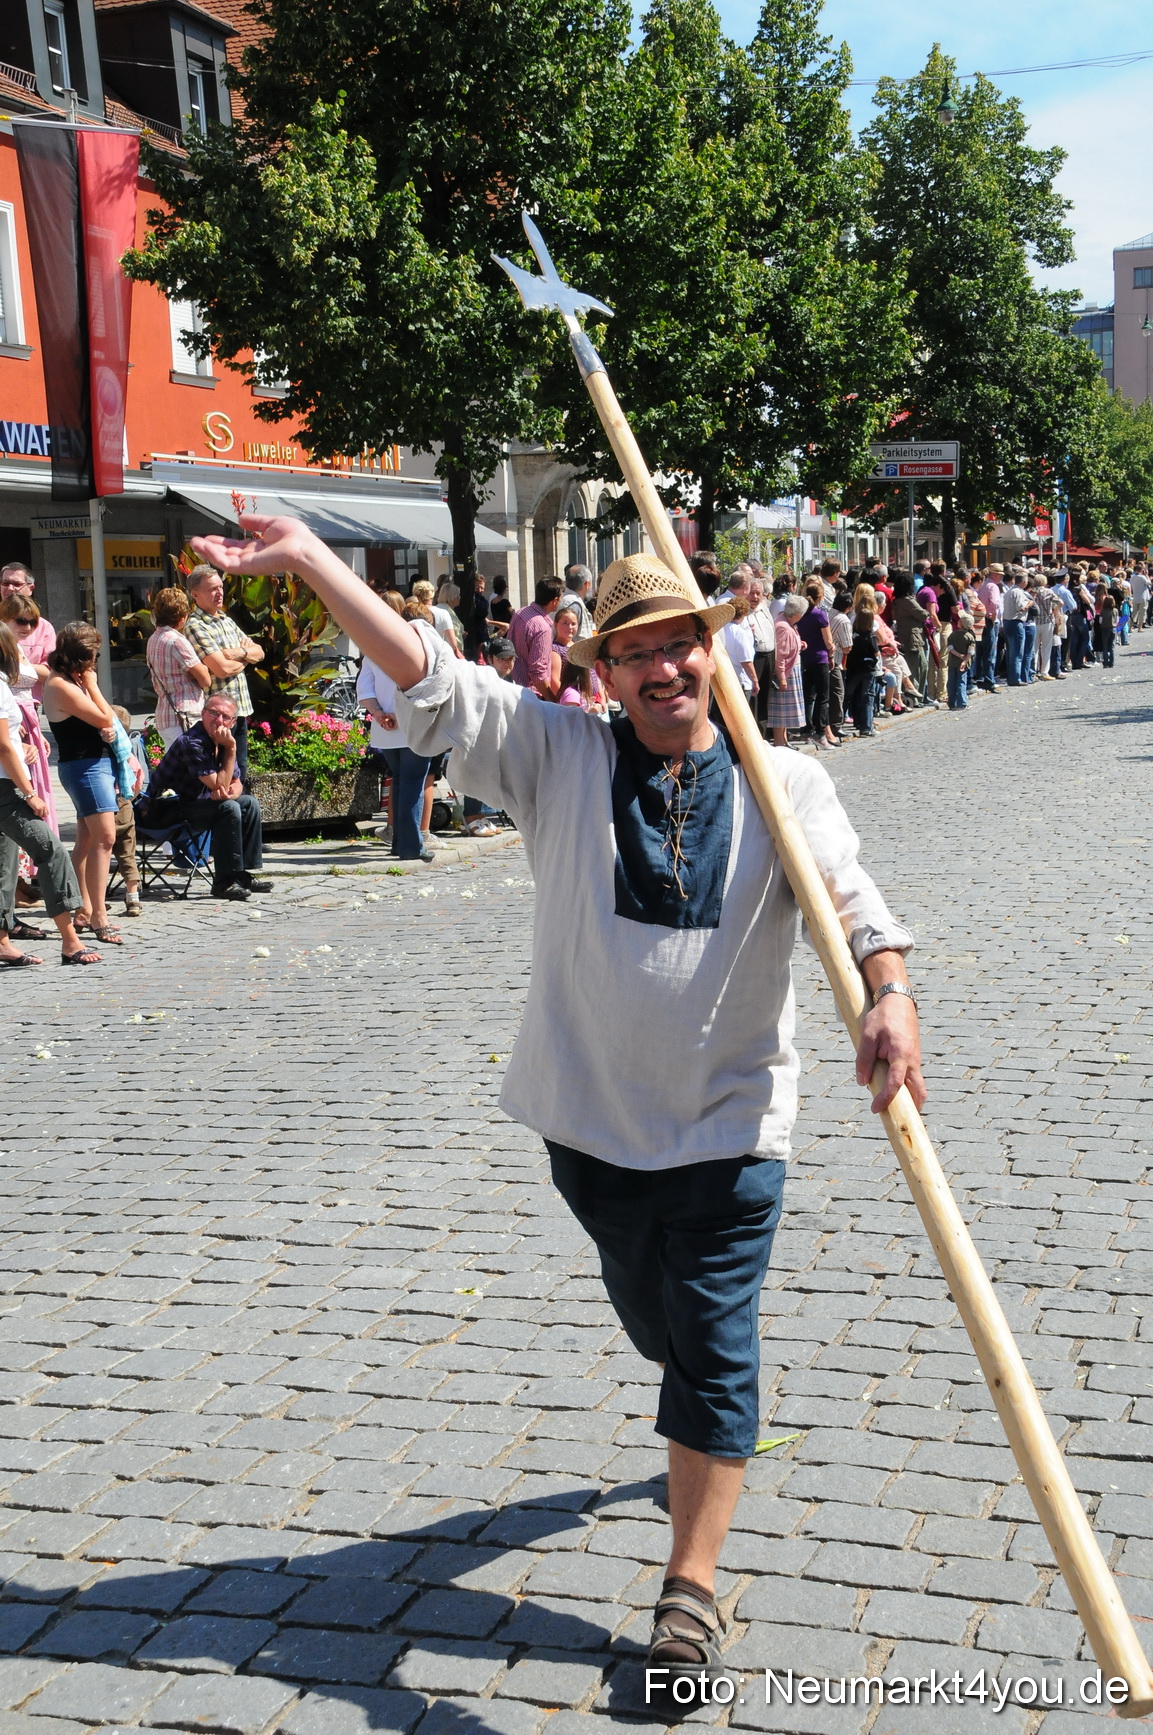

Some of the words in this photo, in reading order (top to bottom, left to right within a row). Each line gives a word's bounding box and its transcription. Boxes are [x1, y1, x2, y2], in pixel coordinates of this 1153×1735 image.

[247, 440, 298, 460] juwelier
[882, 447, 943, 459] Parkleitsystem
[903, 465, 943, 475] Rosengasse
[112, 555, 162, 568] SCHLIERF
